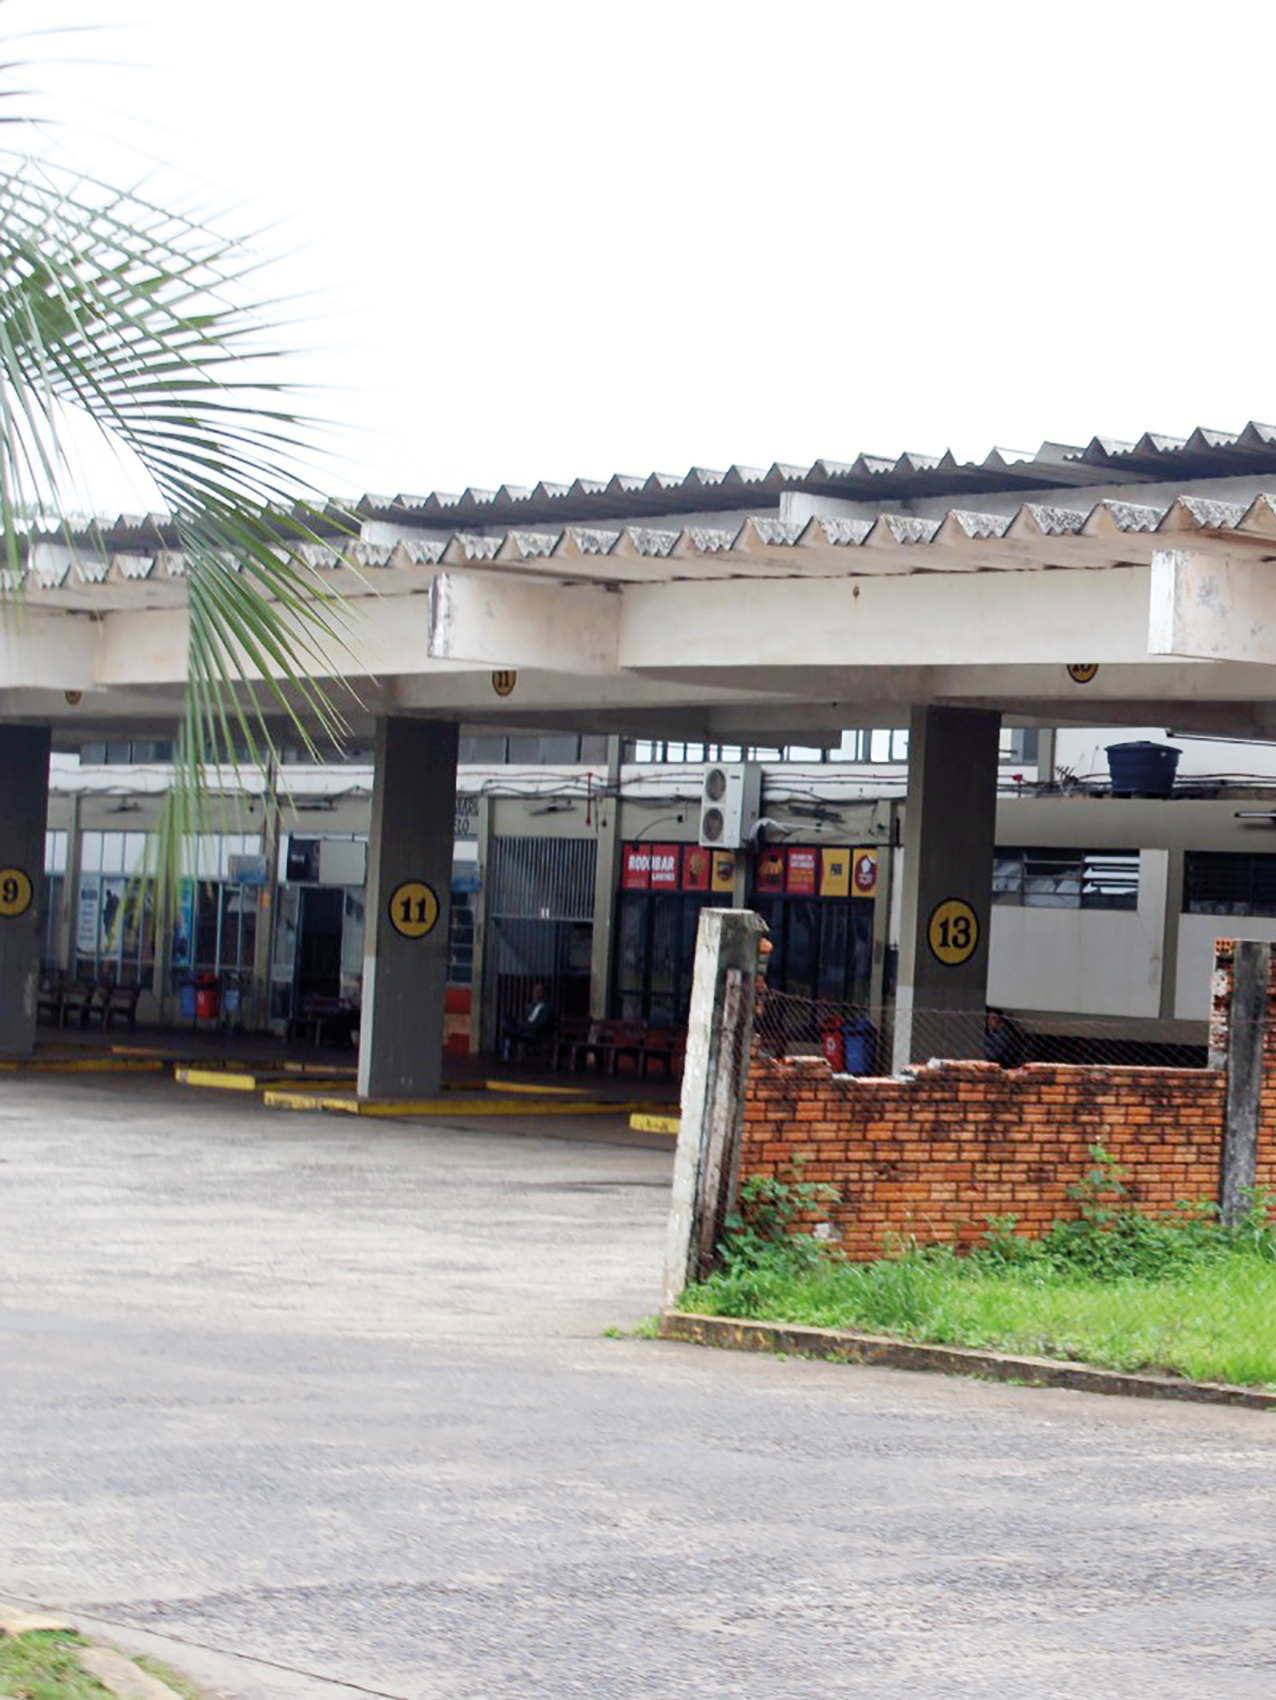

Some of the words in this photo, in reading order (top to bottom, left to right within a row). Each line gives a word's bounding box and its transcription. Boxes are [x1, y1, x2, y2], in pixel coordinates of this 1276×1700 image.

[3, 877, 19, 904] 9
[401, 896, 427, 922] 11
[939, 916, 971, 949] 13
